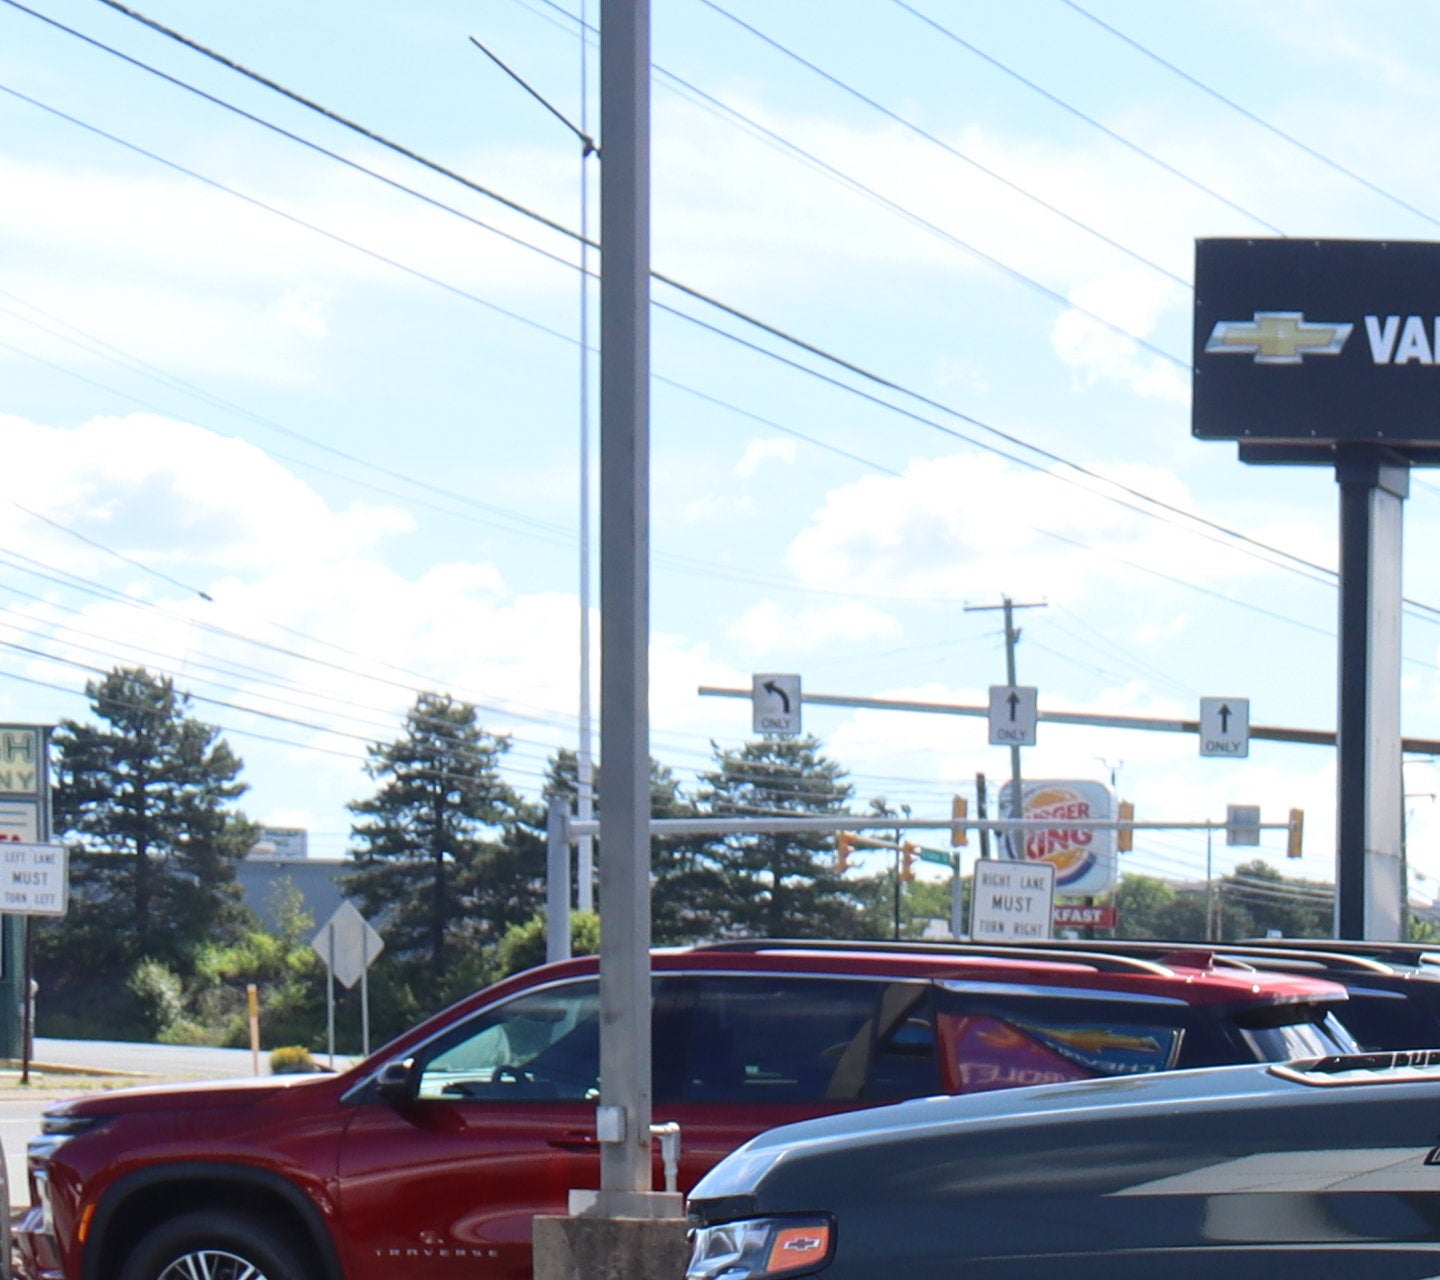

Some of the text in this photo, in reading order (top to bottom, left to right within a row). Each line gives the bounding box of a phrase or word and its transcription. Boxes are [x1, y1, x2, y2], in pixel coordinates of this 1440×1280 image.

[762, 717, 792, 730] ONLY
[997, 728, 1026, 741] ONLY
[1206, 740, 1240, 752] ONLY
[12, 871, 48, 886] MUST
[981, 872, 1045, 892] RIGHT LANE
[992, 894, 1033, 913] MUST
[980, 919, 1043, 937] TURN RIGHT
